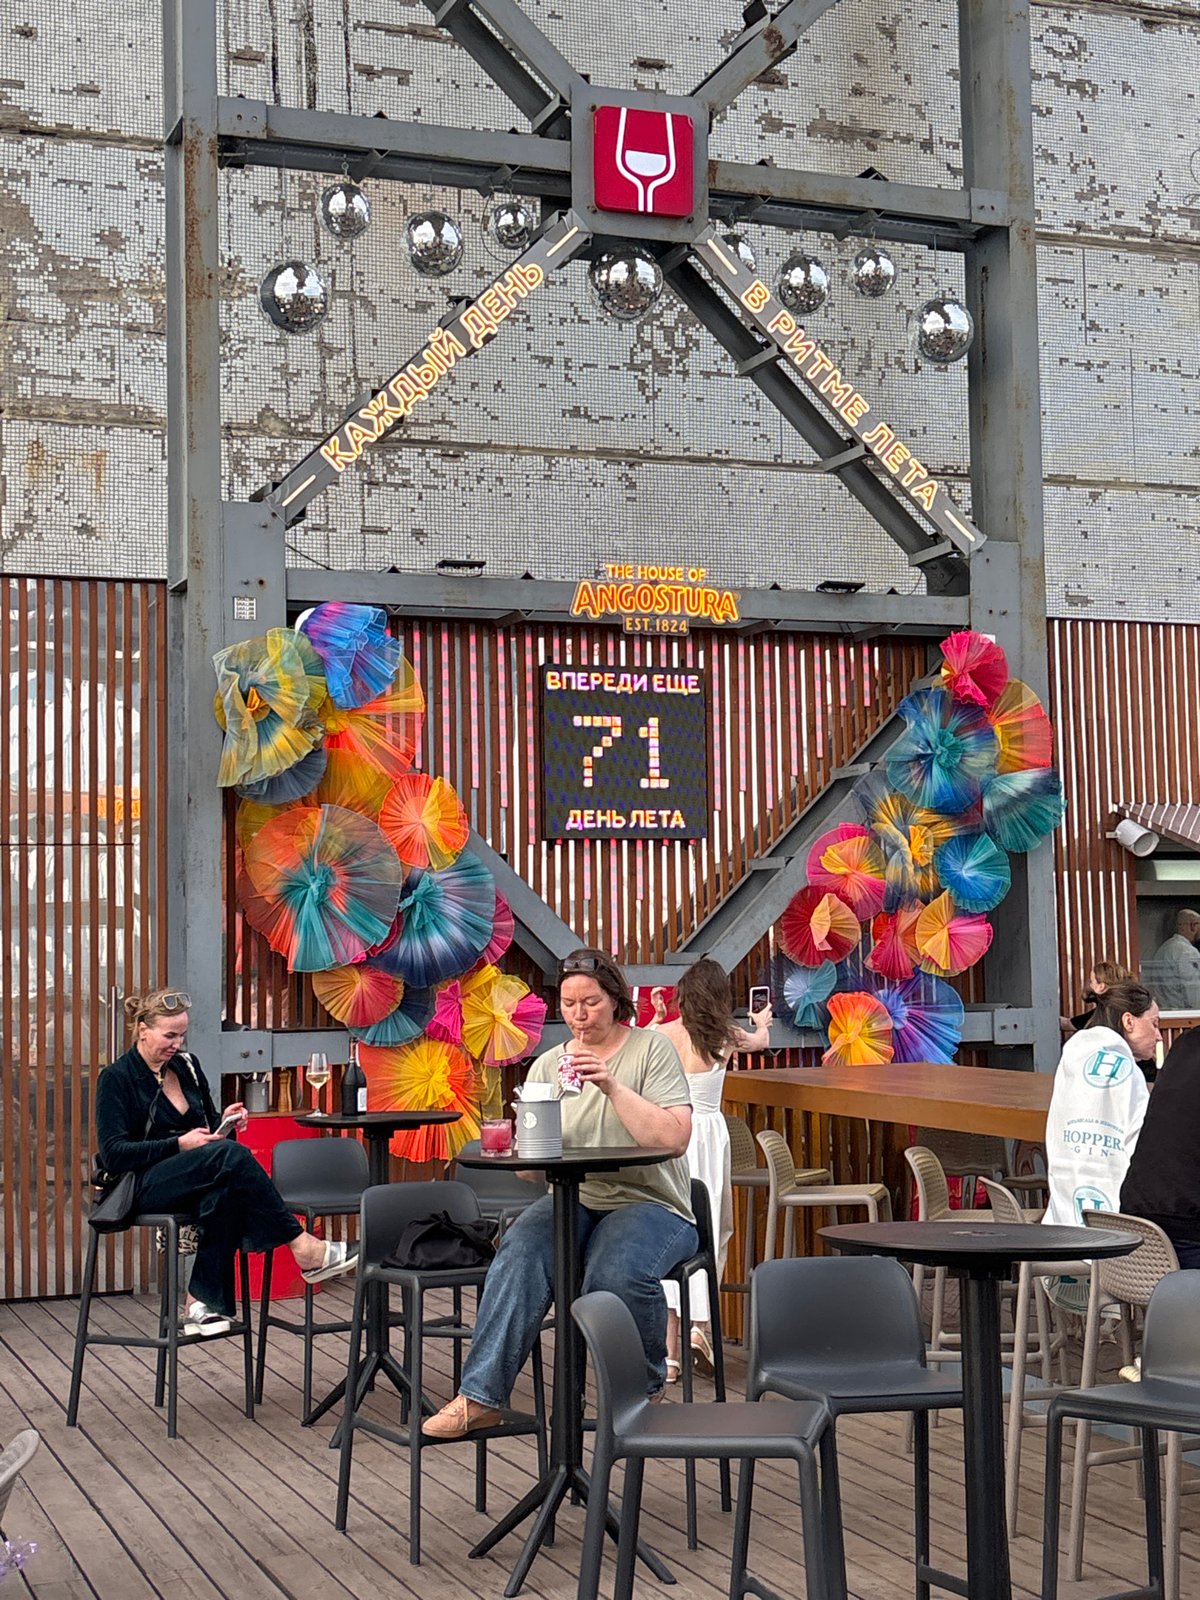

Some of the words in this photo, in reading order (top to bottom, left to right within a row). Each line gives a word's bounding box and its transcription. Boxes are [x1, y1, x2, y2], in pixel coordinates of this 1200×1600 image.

[320, 327, 467, 472] КАЖДЫЙ
[460, 263, 544, 348] ДЕНЬ
[741, 280, 770, 313] В
[767, 310, 870, 427] РИТМЕ
[862, 422, 938, 510] ЛЕТА
[605, 563, 634, 579] THE
[638, 565, 684, 581] HOUSE
[688, 567, 707, 582] OF
[573, 581, 739, 622] ANGOSTURA
[546, 671, 648, 694] ВПЕРЕДИ
[653, 674, 700, 696] ЕЩЕ
[573, 715, 670, 788] 71
[565, 809, 626, 831] ДЕНЬ
[629, 809, 686, 829] ЛЕТА
[1087, 1050, 1128, 1080] H
